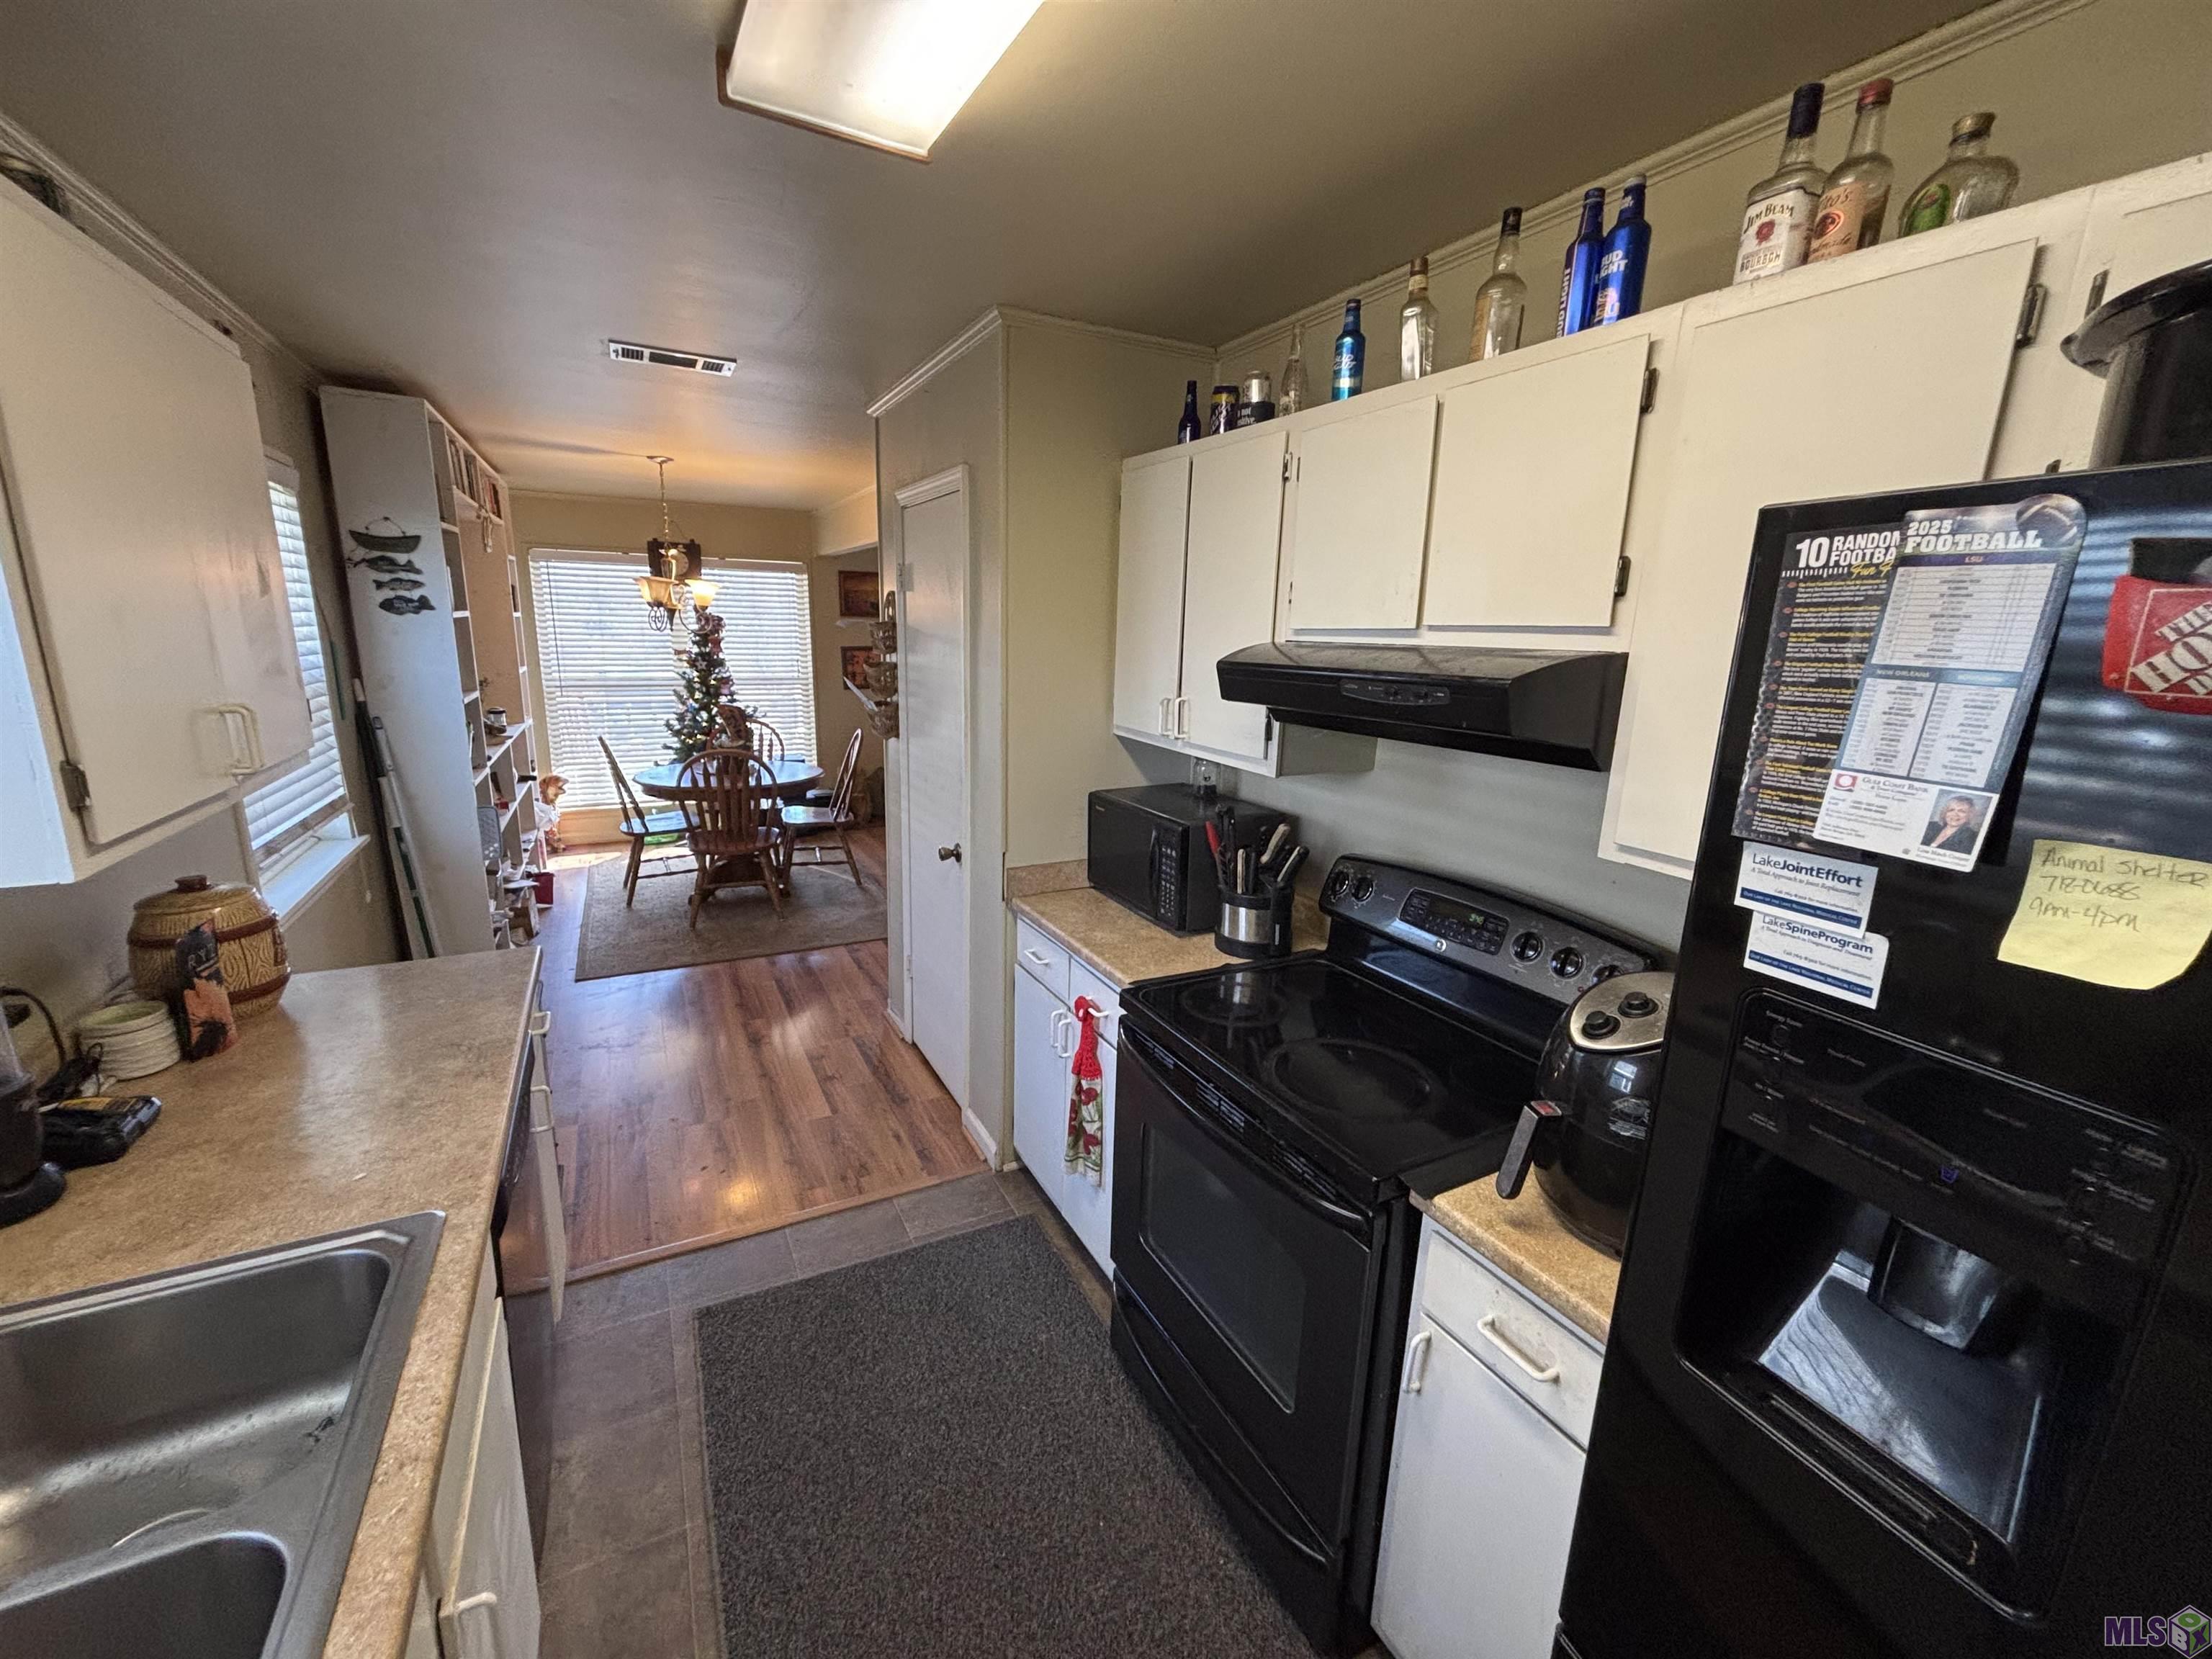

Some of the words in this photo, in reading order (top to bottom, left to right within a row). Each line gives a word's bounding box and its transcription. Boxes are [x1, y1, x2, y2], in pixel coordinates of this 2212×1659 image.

[1743, 211, 1763, 235] JIM
[1764, 203, 1795, 219] BEAM
[1904, 530, 2043, 554] FOOTBALL
[1907, 520, 1954, 536] 2025
[1797, 536, 1830, 567] 10
[2131, 629, 2212, 693] HO
[1753, 853, 1863, 888] LakeJointEffort
[2041, 847, 2103, 873] Animal
[1763, 915, 1874, 954] LakeSpineProgram
